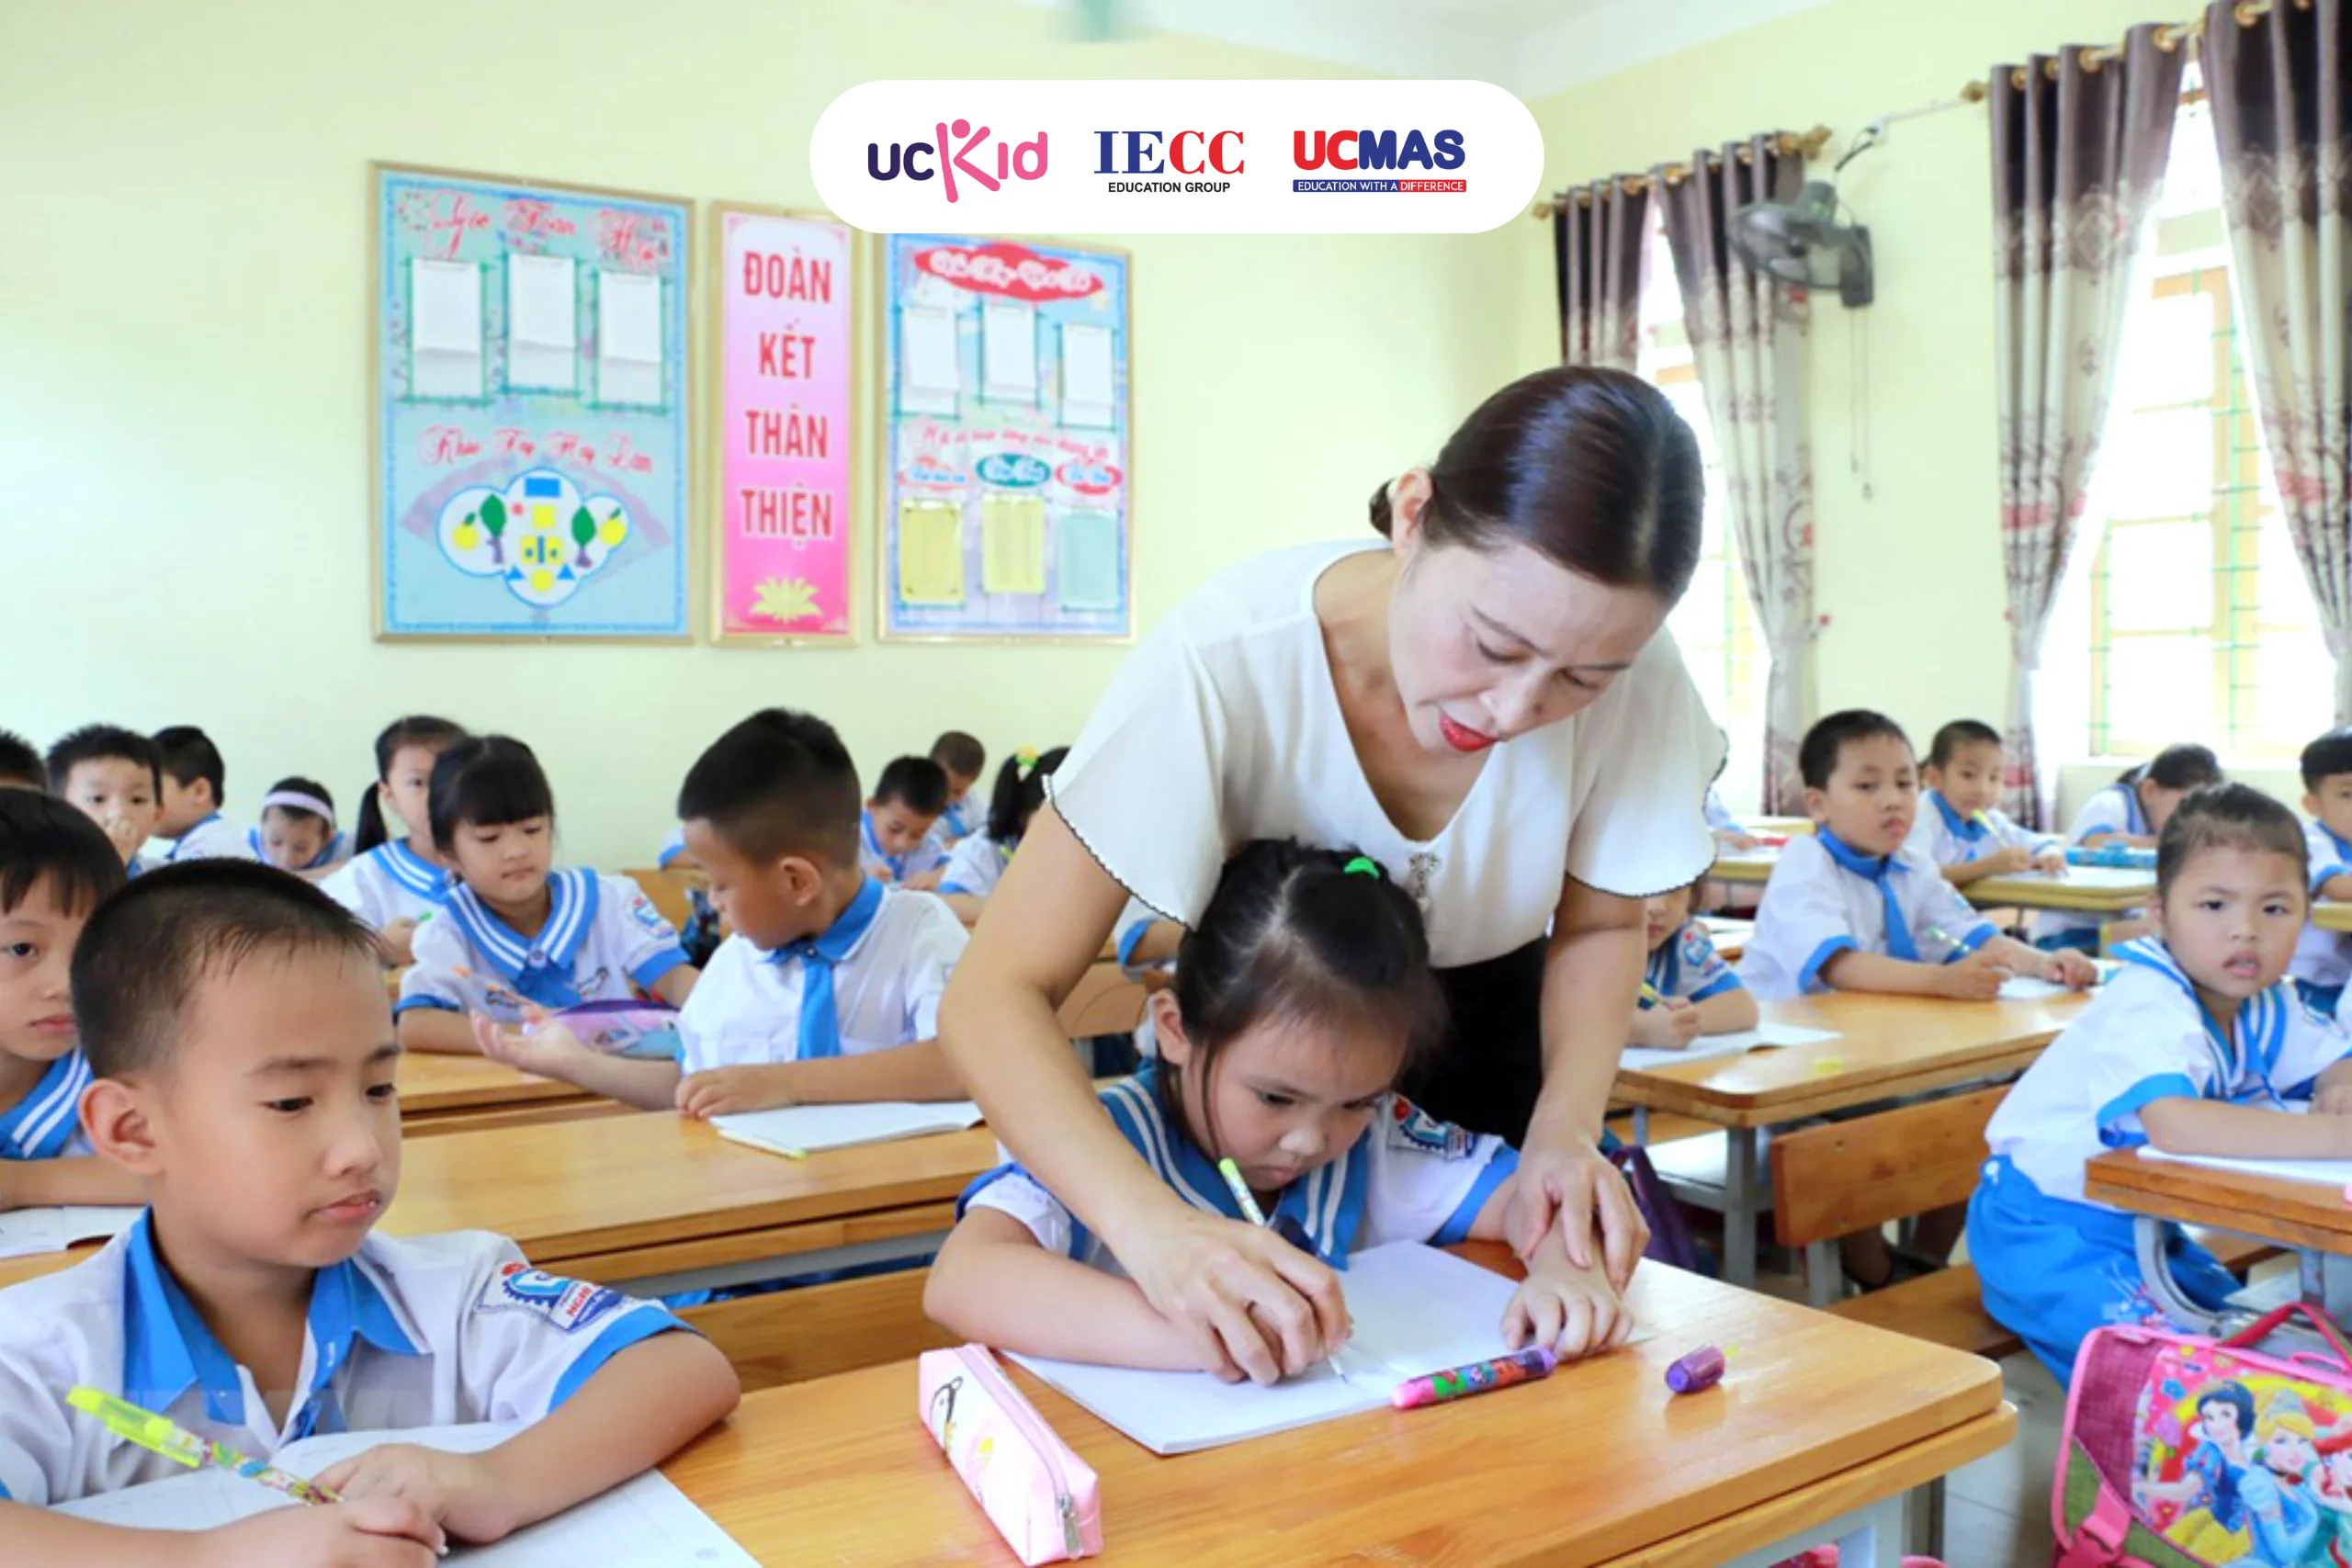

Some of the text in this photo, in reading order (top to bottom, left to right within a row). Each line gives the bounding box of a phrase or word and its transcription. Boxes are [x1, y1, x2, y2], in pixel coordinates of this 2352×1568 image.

[743, 245, 831, 304] ĐOÀN
[759, 317, 816, 379] KẾT
[745, 402, 828, 458] THÂN
[741, 481, 832, 547] THIỆN
